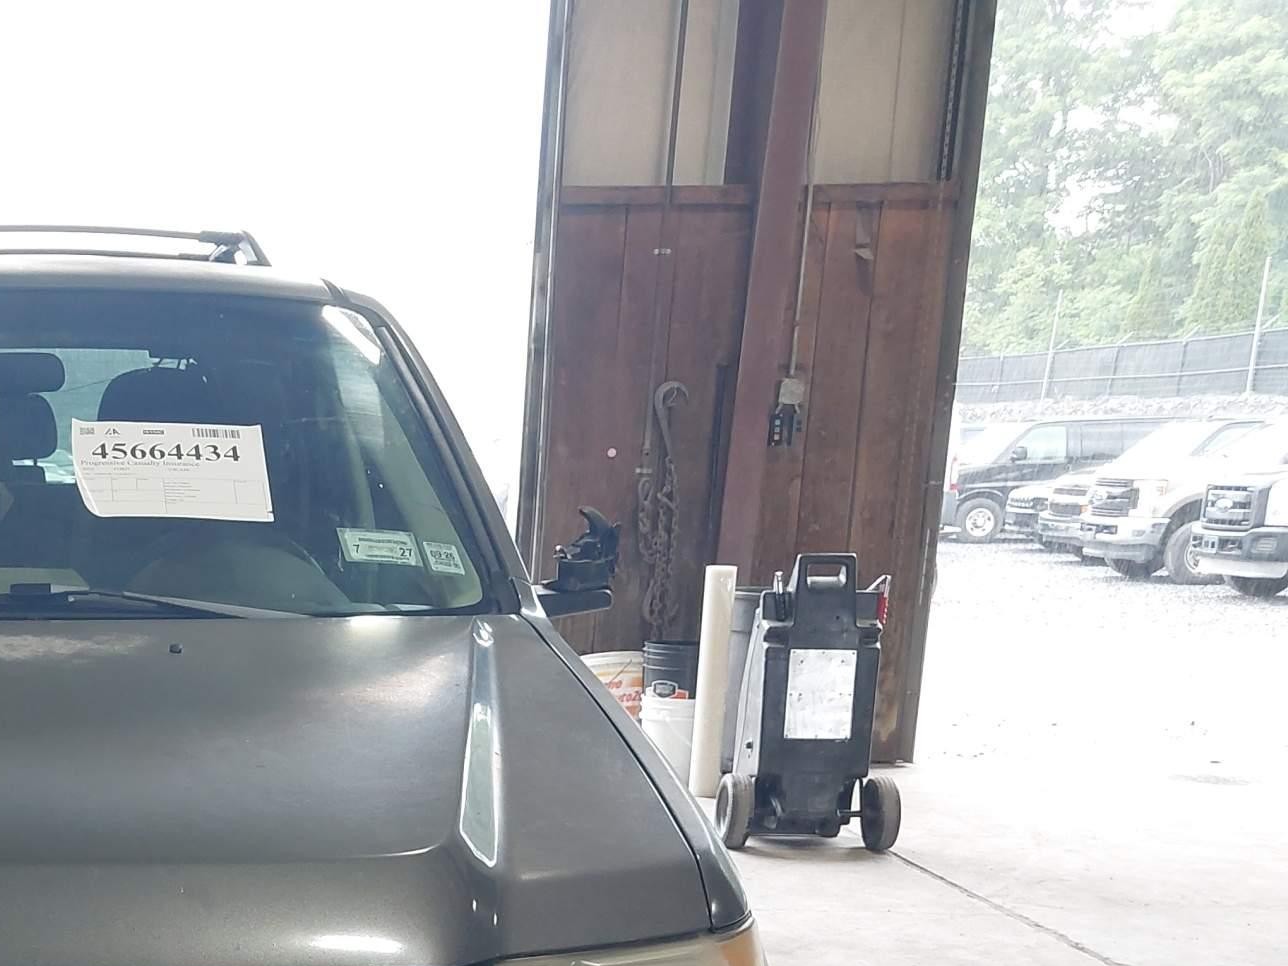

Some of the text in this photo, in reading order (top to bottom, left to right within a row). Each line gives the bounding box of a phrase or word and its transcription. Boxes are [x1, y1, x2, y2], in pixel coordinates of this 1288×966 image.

[91, 442, 240, 462] 45664434
[80, 459, 125, 467] Progressive
[398, 547, 413, 557] 27
